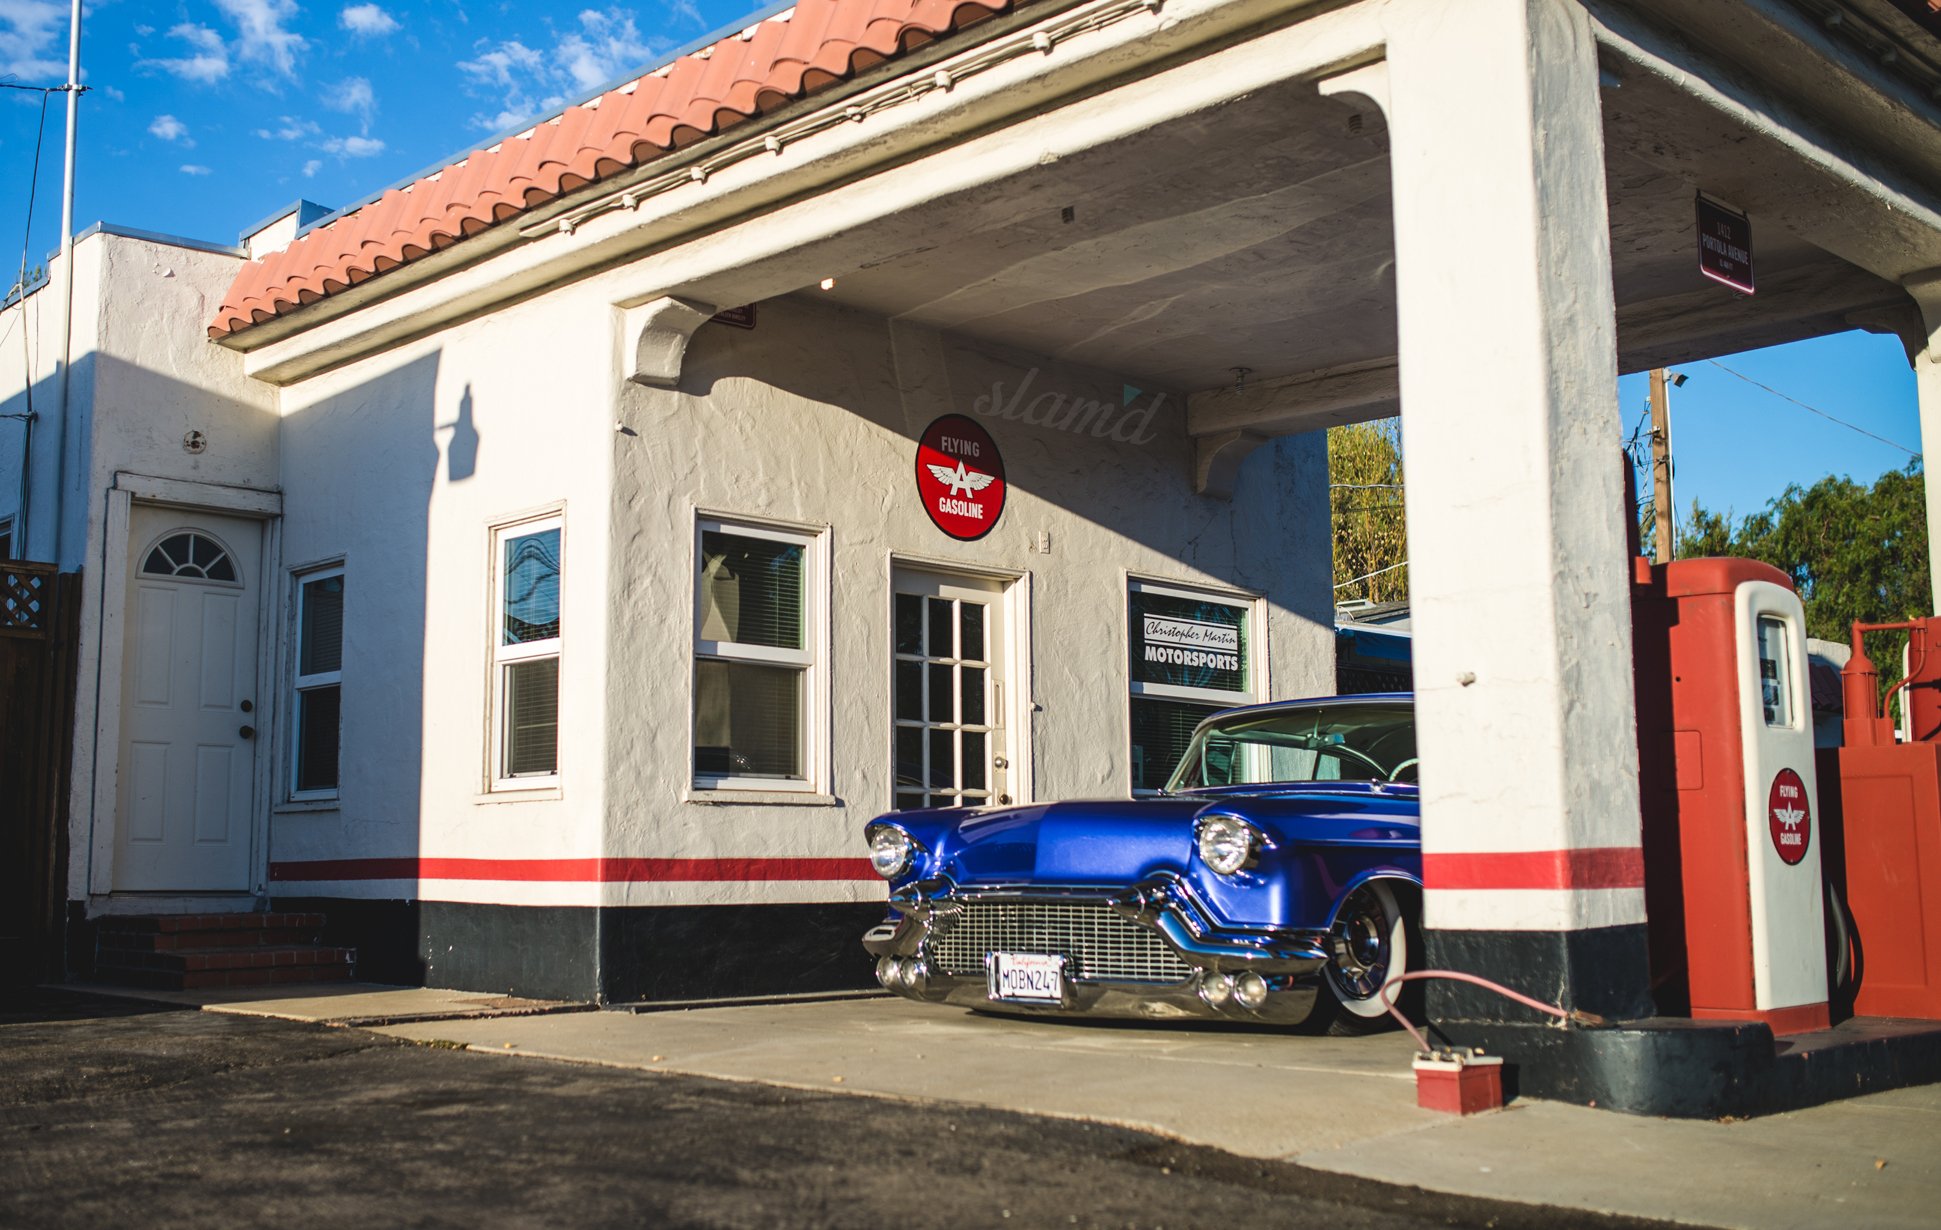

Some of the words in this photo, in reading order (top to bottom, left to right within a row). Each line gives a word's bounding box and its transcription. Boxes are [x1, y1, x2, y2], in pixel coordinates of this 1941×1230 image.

[1728, 244, 1749, 265] AVENUE
[941, 436, 980, 457] FLYING
[939, 497, 983, 519] GASOLINE
[1146, 622, 1200, 642] Christopher
[1202, 629, 1236, 644] Martin
[1145, 646, 1238, 671] MOTORSPORTS
[1780, 786, 1798, 798] FLYING
[1780, 833, 1801, 845] GASOLINE
